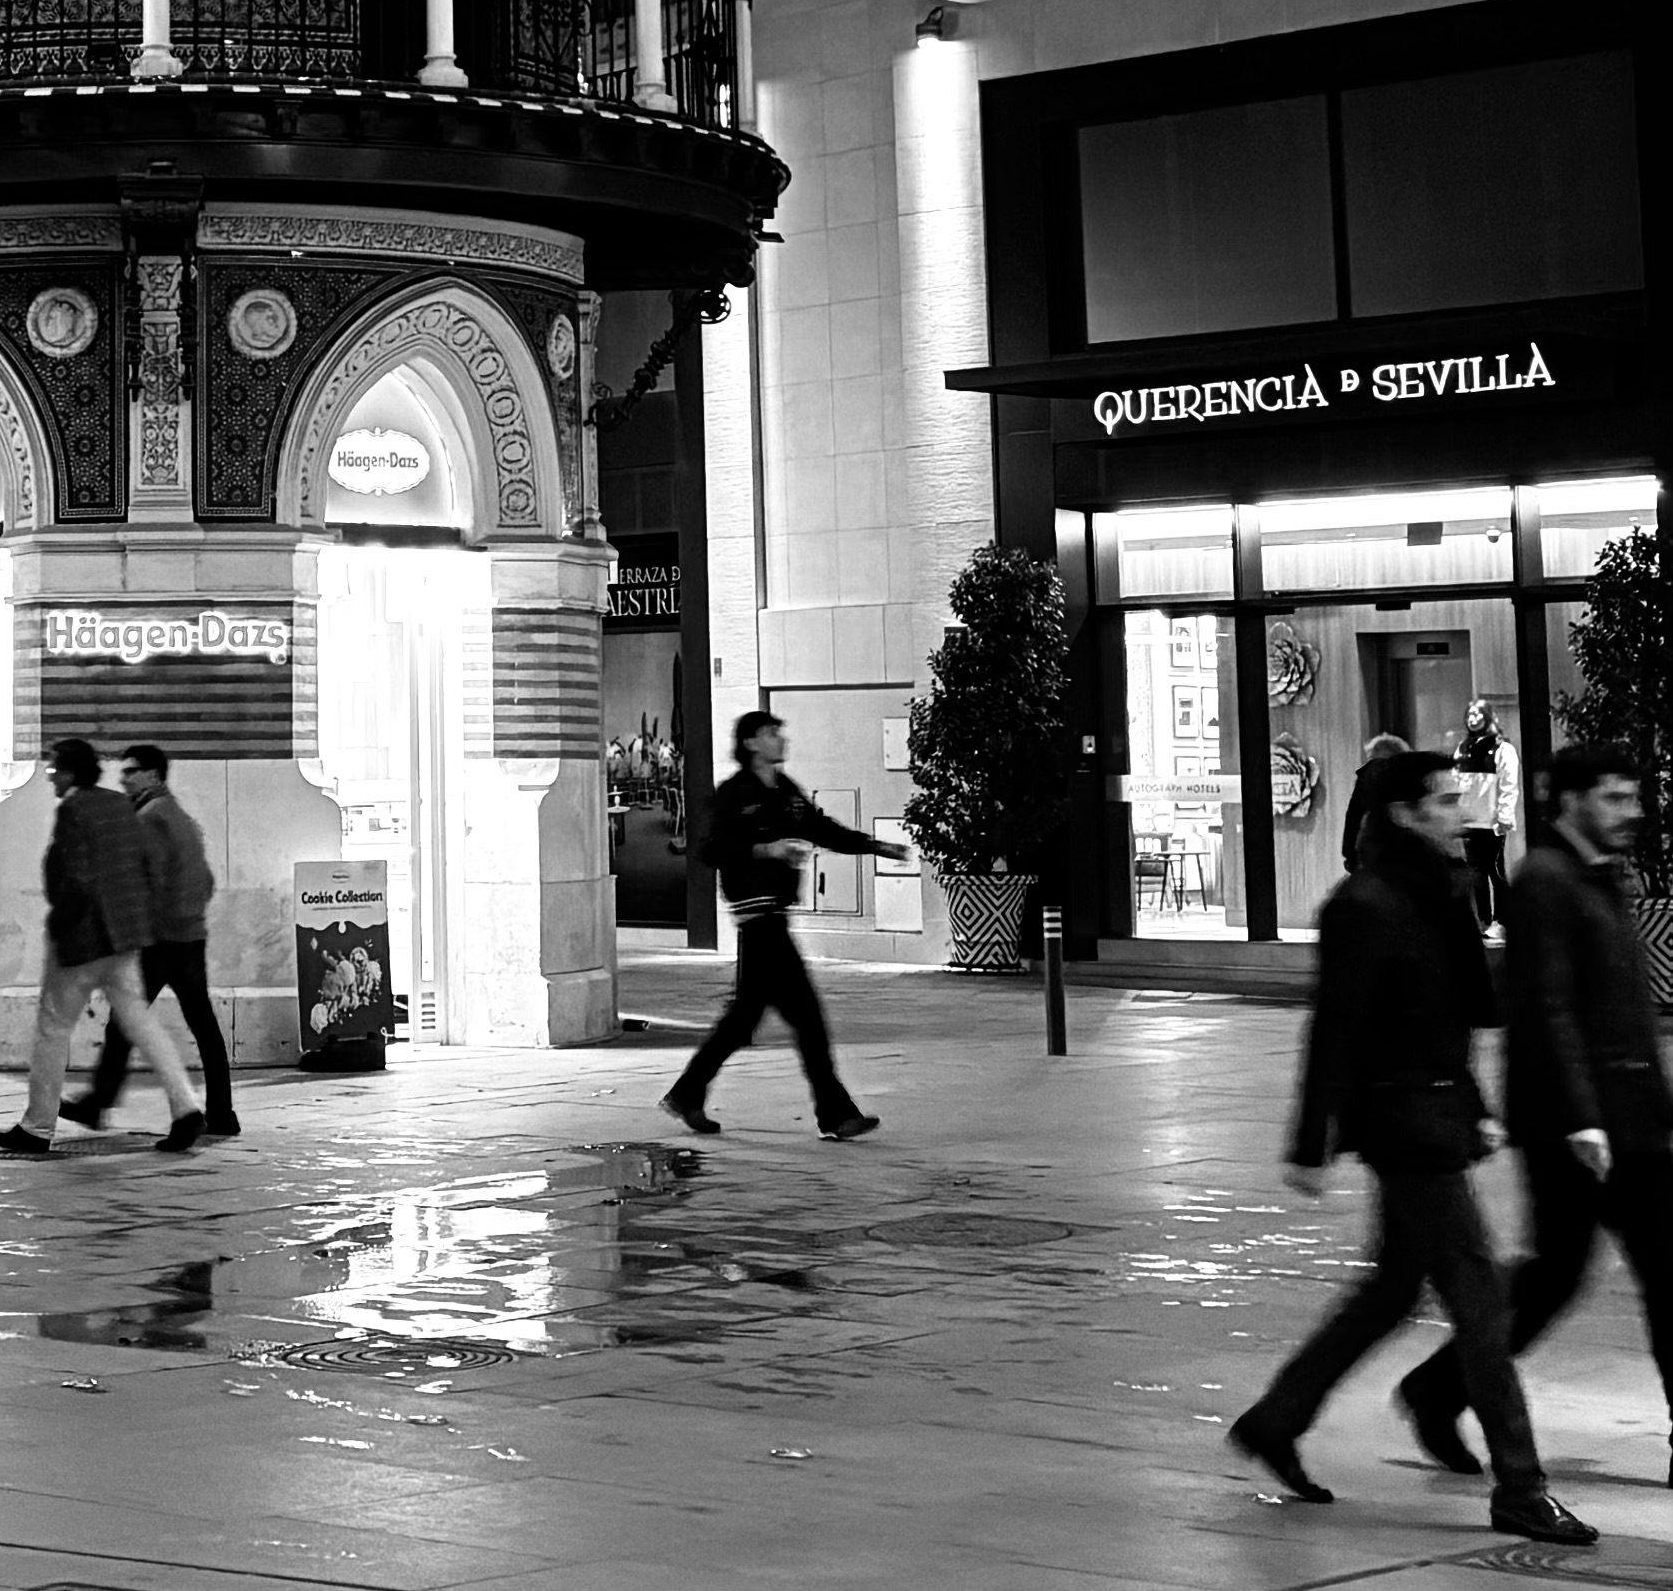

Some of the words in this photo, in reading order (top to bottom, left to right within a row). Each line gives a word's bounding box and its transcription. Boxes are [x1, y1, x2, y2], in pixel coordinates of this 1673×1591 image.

[1093, 364, 1328, 436] QUERENCIA
[1372, 342, 1556, 401] SEVILLA
[618, 566, 668, 585] ERRAZA
[301, 891, 333, 905] Cookie
[335, 890, 383, 904] Collection
